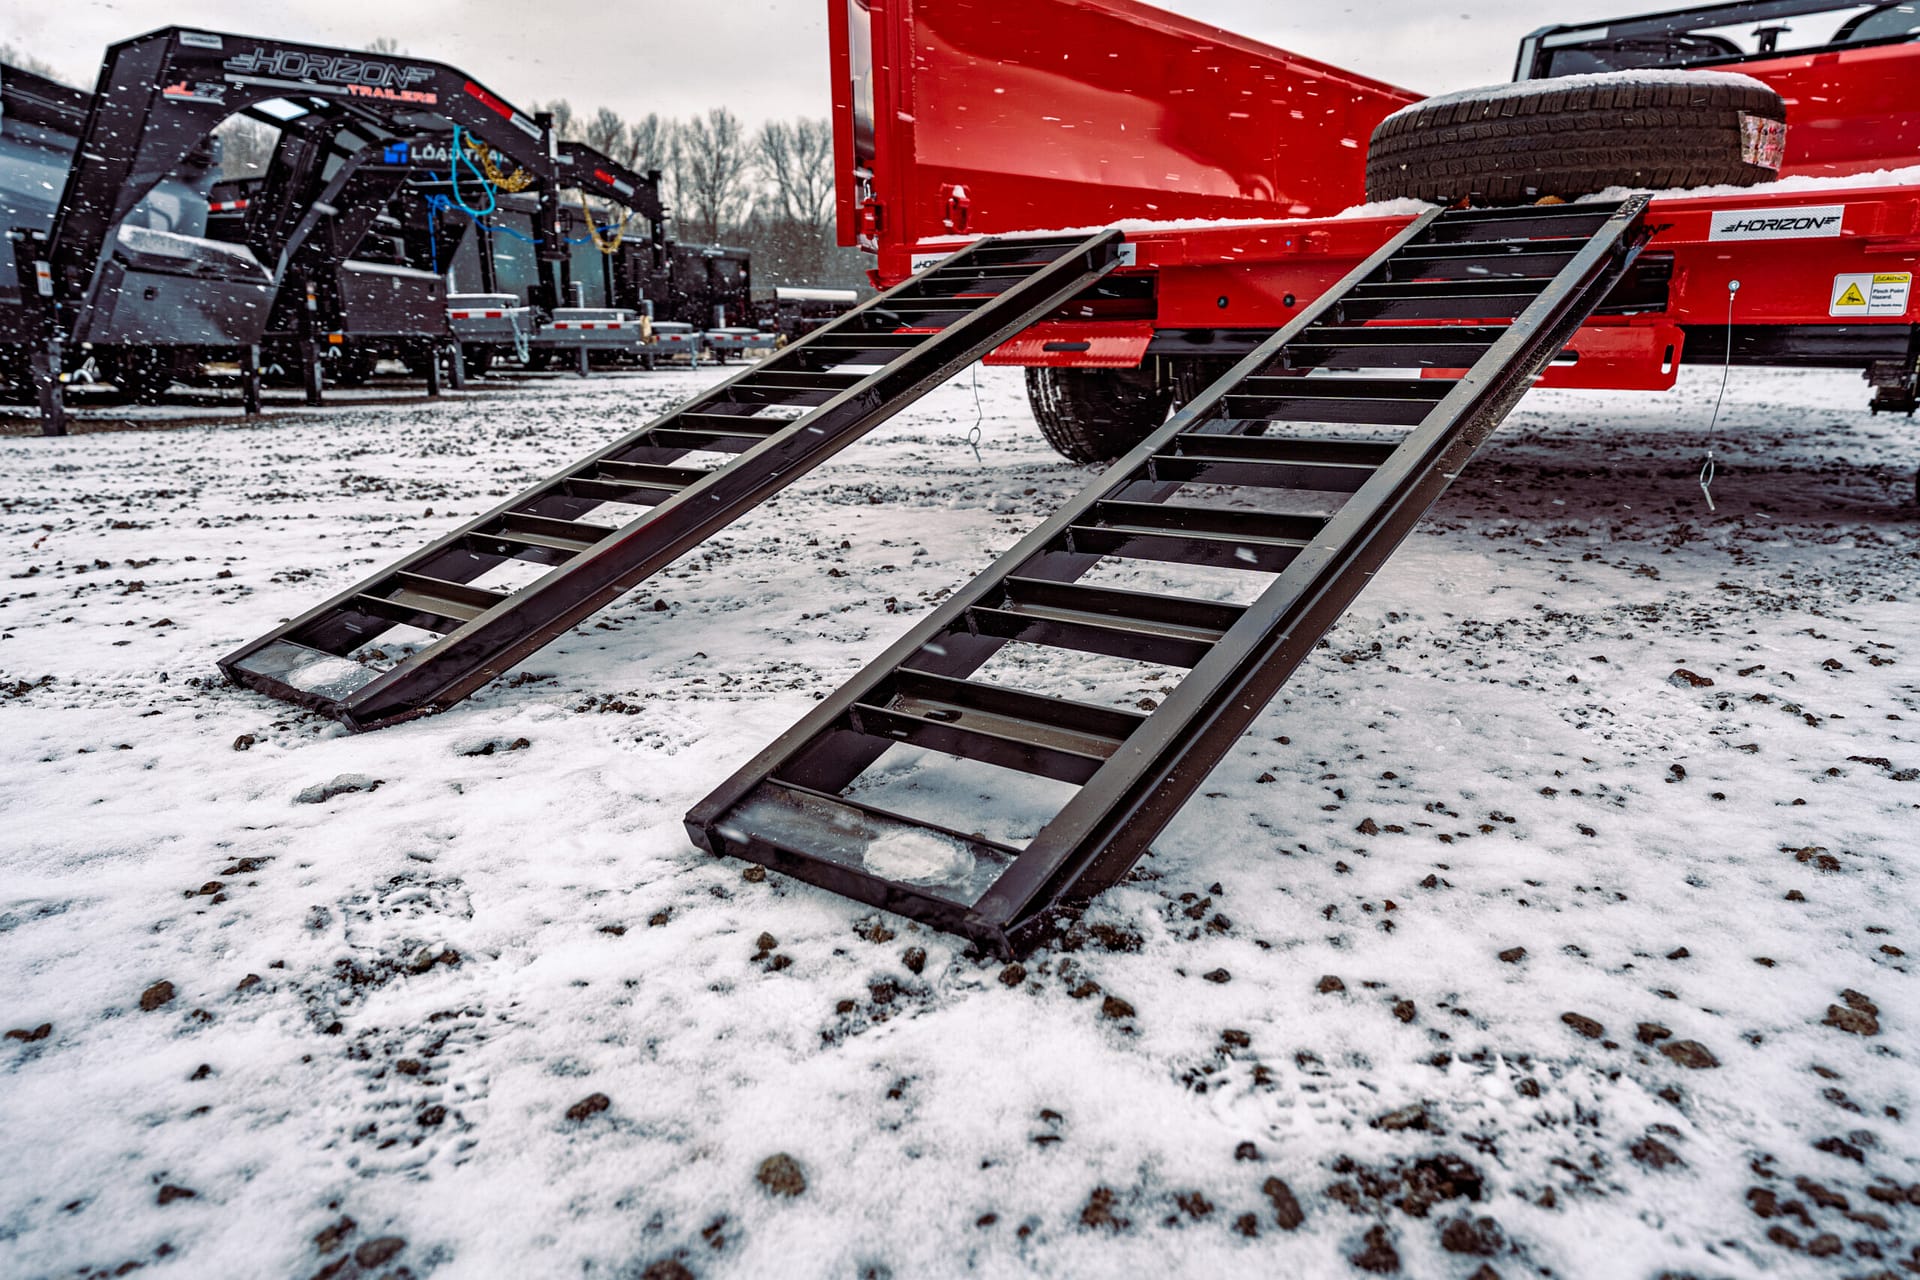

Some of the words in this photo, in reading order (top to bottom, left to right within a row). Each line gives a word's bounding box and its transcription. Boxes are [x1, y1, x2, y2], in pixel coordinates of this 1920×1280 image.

[223, 47, 435, 88] HORIZON
[347, 84, 437, 105] TRAILERS
[1720, 216, 1840, 233] HORIZON
